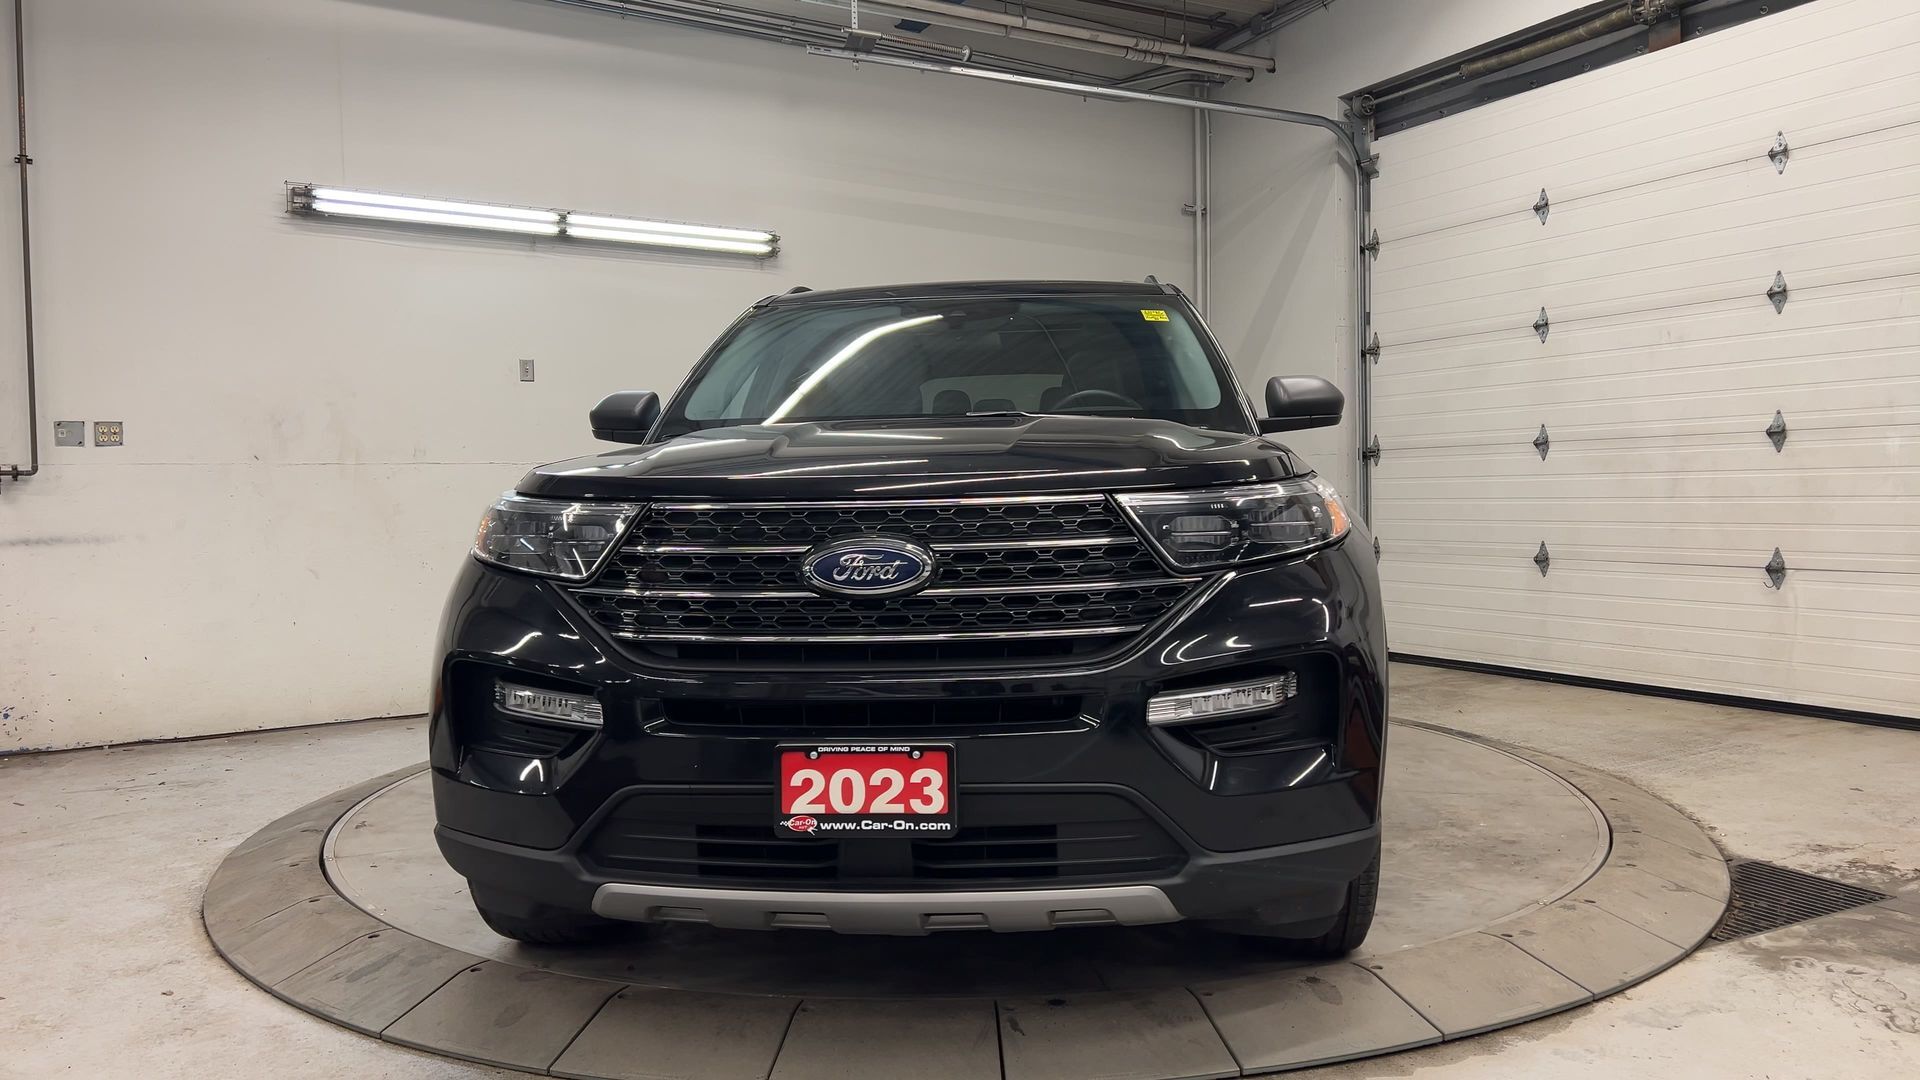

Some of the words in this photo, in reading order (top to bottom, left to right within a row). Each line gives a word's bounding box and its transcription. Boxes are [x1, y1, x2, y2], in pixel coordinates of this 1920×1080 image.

[833, 554, 908, 580] Ford
[790, 768, 945, 815] 2023
[820, 820, 951, 831] www.Car-On.com
